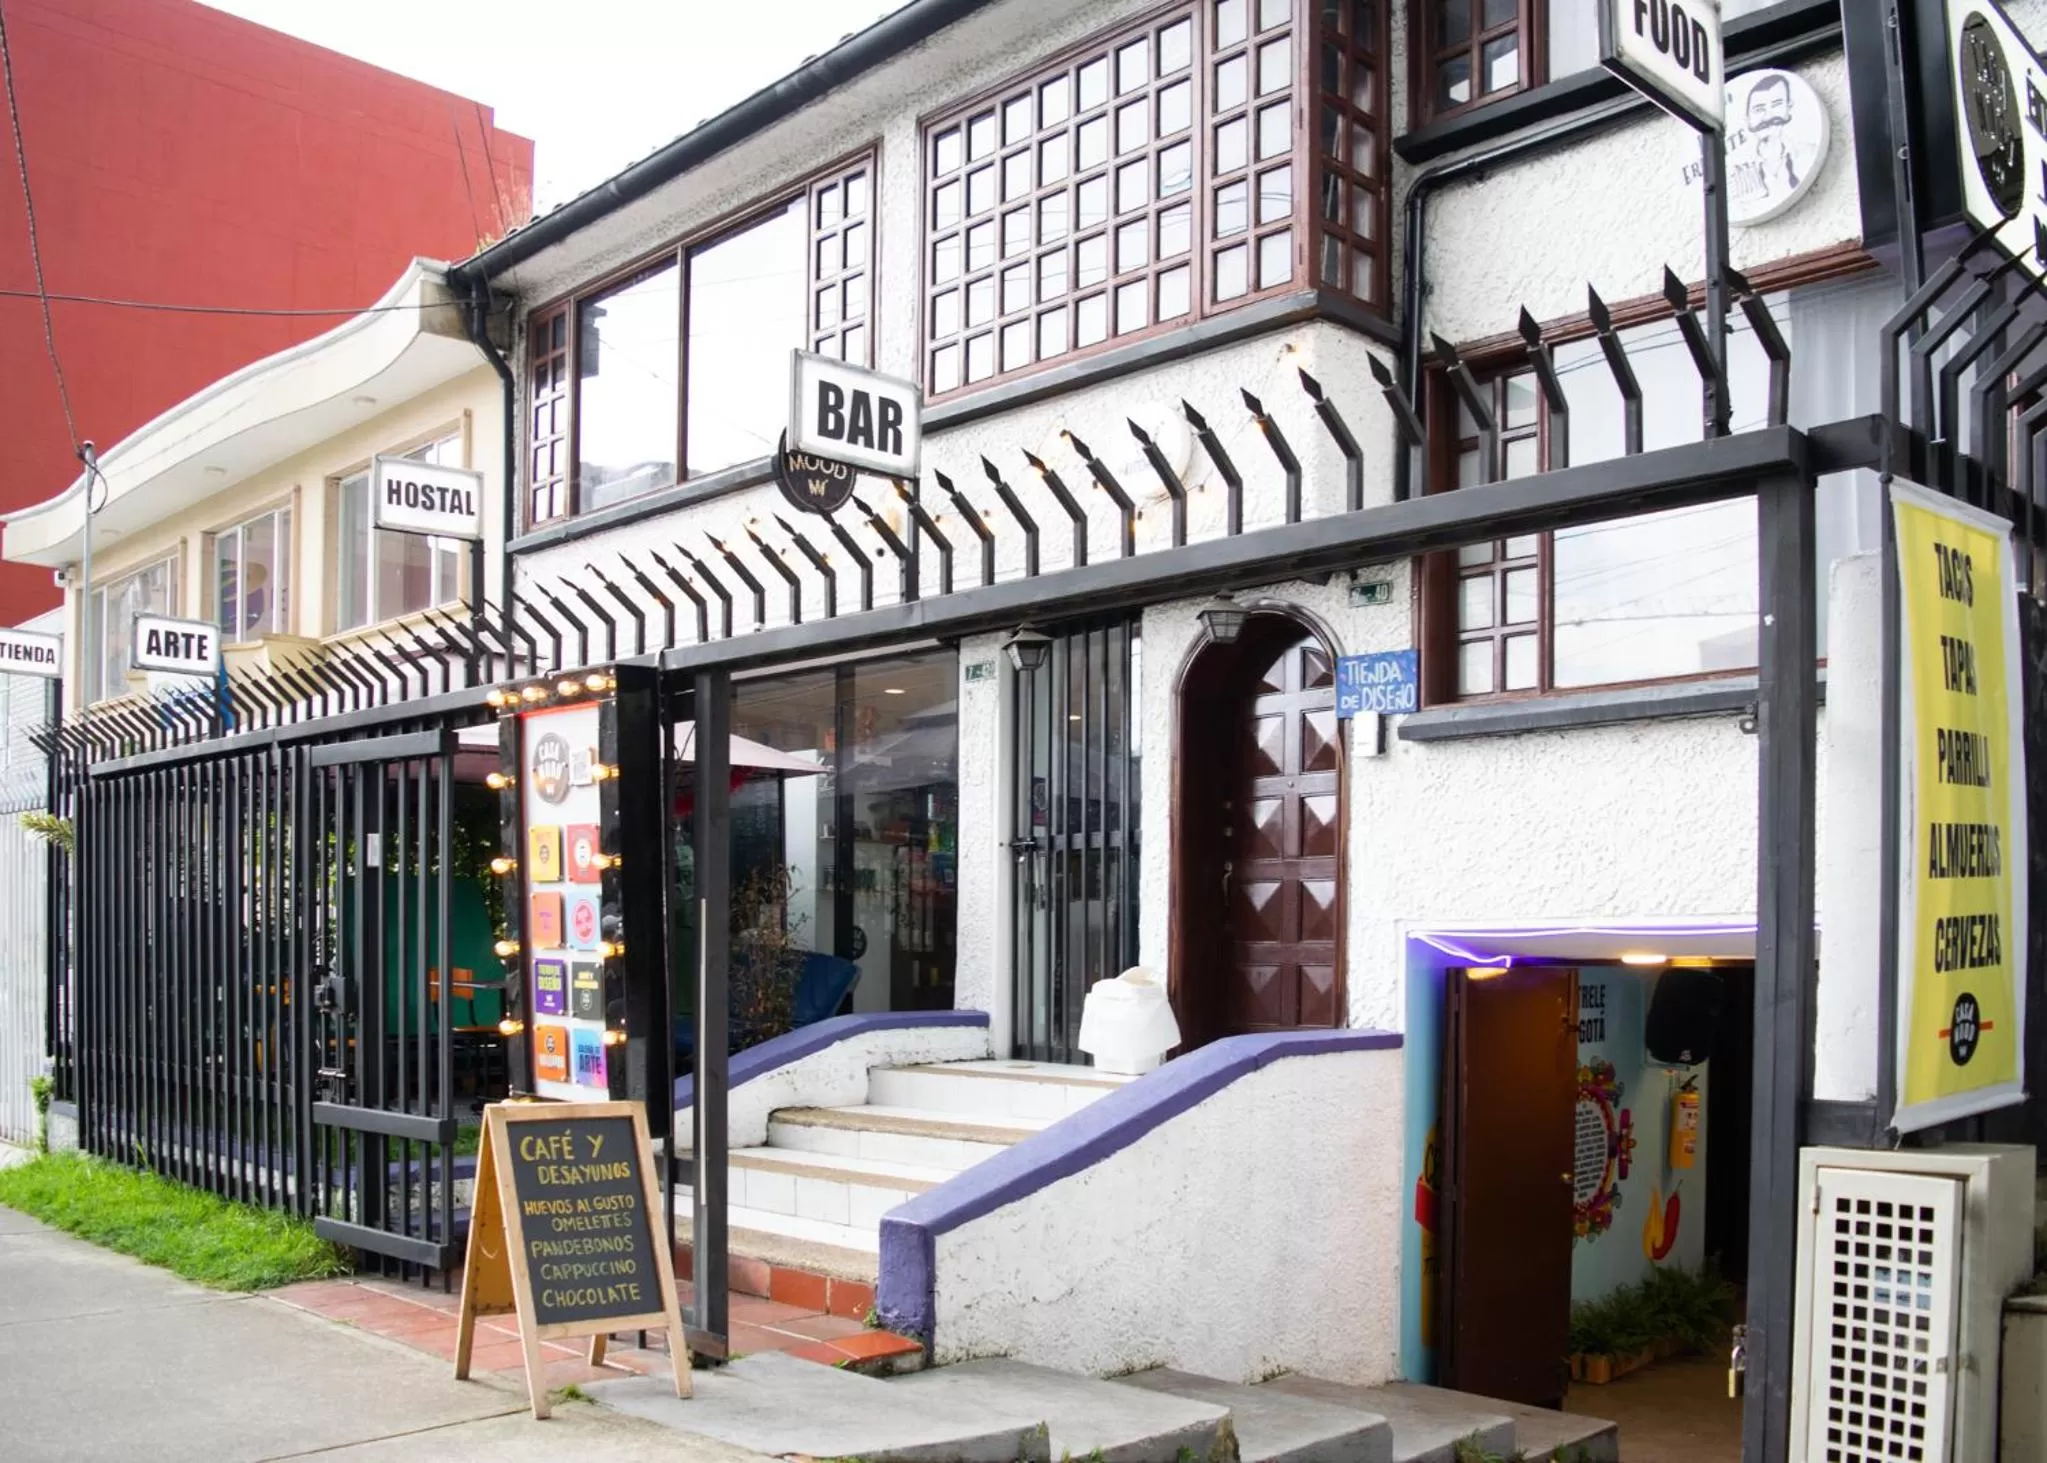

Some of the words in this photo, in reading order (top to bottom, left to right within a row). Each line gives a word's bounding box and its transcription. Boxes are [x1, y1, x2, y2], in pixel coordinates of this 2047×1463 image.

[1634, 0, 1709, 85] FOOD
[818, 379, 902, 456] BAR
[788, 454, 847, 480] MOOD
[387, 479, 475, 516] HOSTAL
[0, 643, 55, 664] TIENDA
[146, 629, 208, 661] ARTE
[1345, 661, 1402, 686] TIENDA
[1341, 695, 1360, 709] DE
[1361, 683, 1416, 712] DISEÑO
[1935, 913, 2001, 974] CERVEZAS
[520, 1128, 576, 1161] CAFÉ
[586, 1135, 604, 1158] Y
[537, 1162, 631, 1185] DESAYUNOS
[524, 1199, 573, 1216] HUEVOS
[577, 1198, 592, 1213] AL
[593, 1194, 635, 1211] GUSTO
[551, 1212, 632, 1232] OMELETTES
[531, 1234, 634, 1258] PANDEBONOS
[540, 1259, 636, 1280] CAPPUCCINO
[542, 1283, 641, 1307] CHOCOLATE
